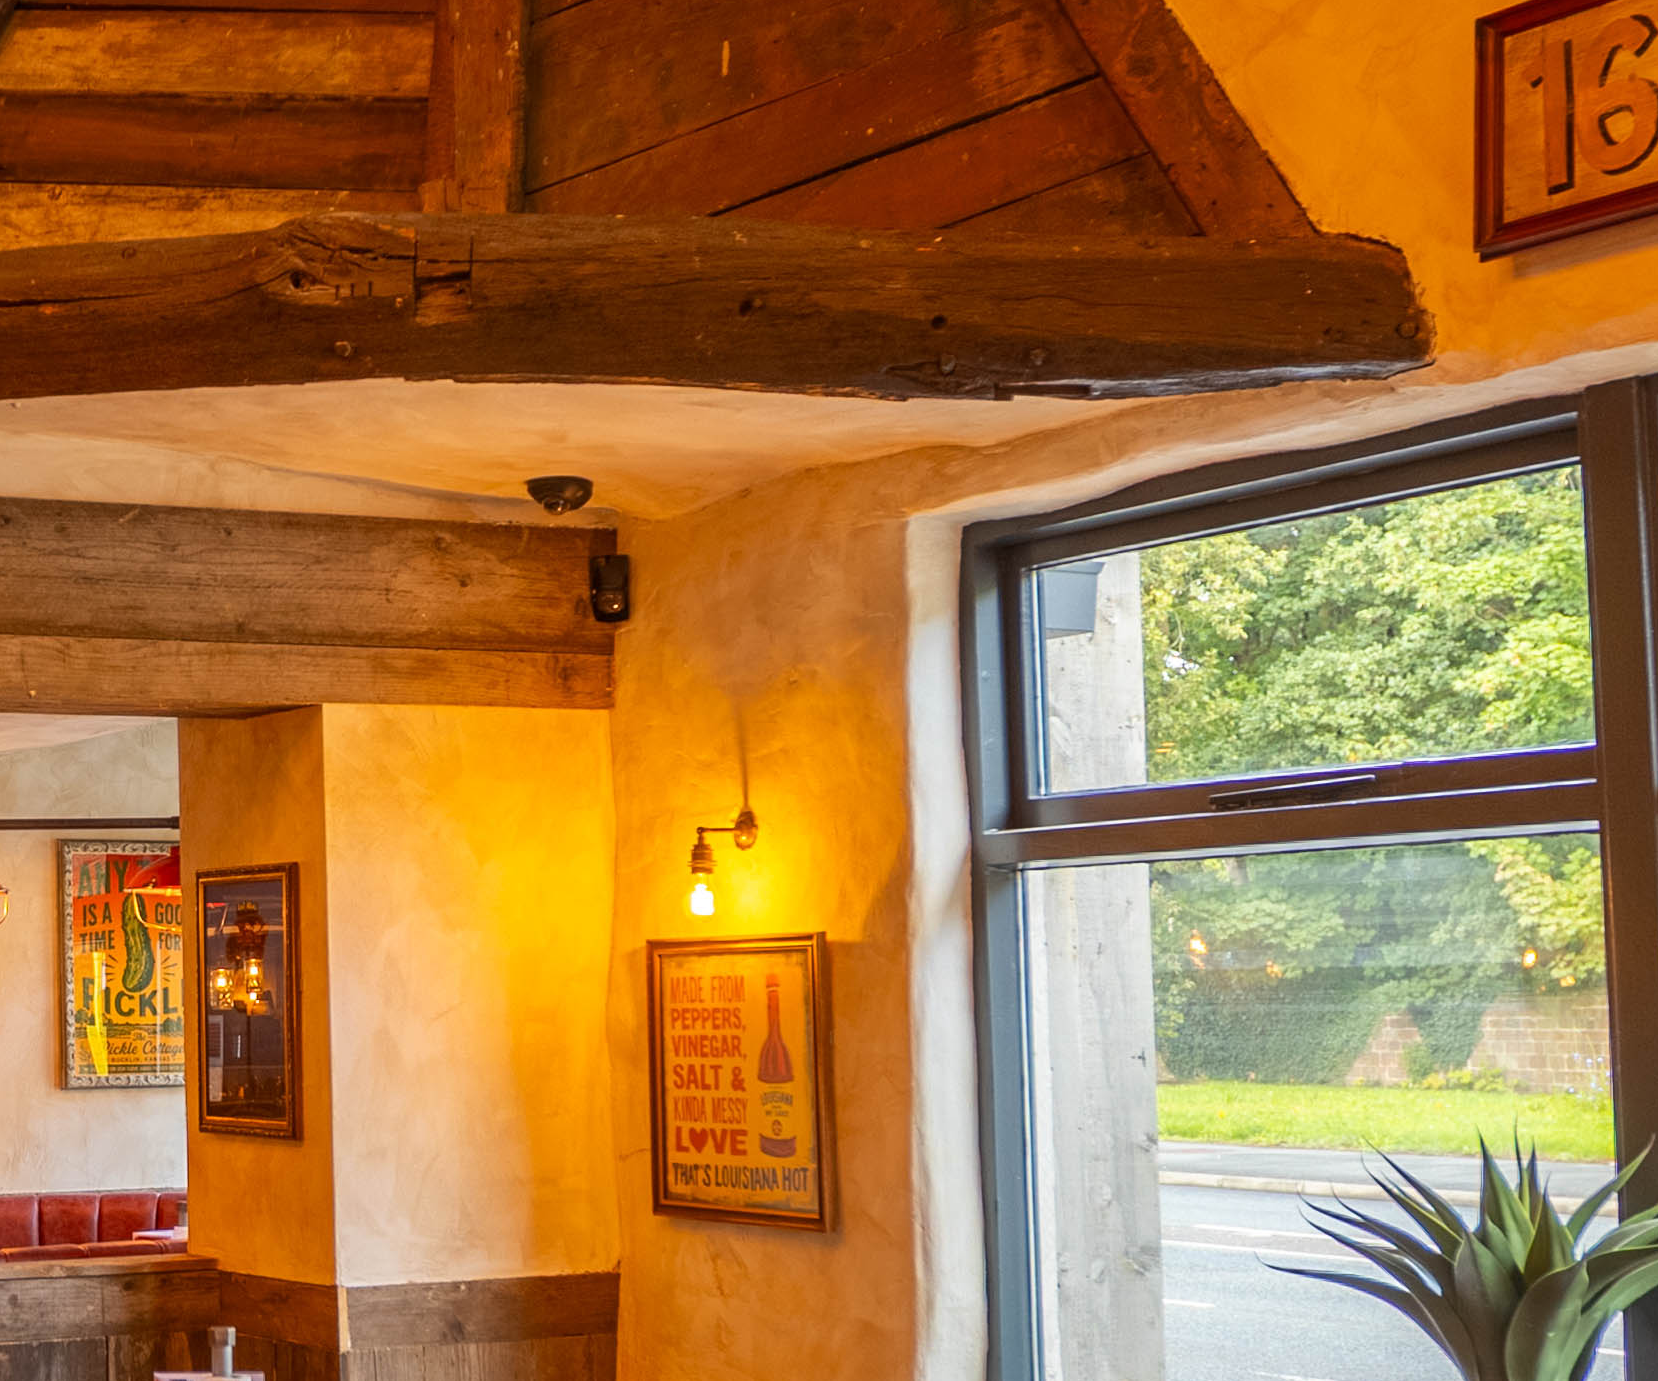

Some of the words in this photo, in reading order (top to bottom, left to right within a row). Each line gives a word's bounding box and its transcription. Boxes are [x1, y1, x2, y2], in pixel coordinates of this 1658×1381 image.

[78, 860, 128, 899] ANY
[83, 903, 97, 927] IS
[102, 902, 112, 924] A
[80, 930, 115, 953] TIME
[158, 932, 182, 951] FOR
[82, 977, 179, 1017] PICKL
[670, 976, 704, 1004] MADE
[710, 975, 745, 1003] FROM
[671, 1007, 747, 1032] PEPPERS,
[671, 1034, 748, 1059] VINEGAR,
[673, 1064, 723, 1092] SALT
[730, 1066, 747, 1092] &
[673, 1096, 707, 1123] KINDA
[711, 1096, 748, 1124] MESSY
[672, 1162, 711, 1186] THAT'S
[715, 1164, 779, 1191] LOUISIANA
[782, 1166, 809, 1192] HOT
